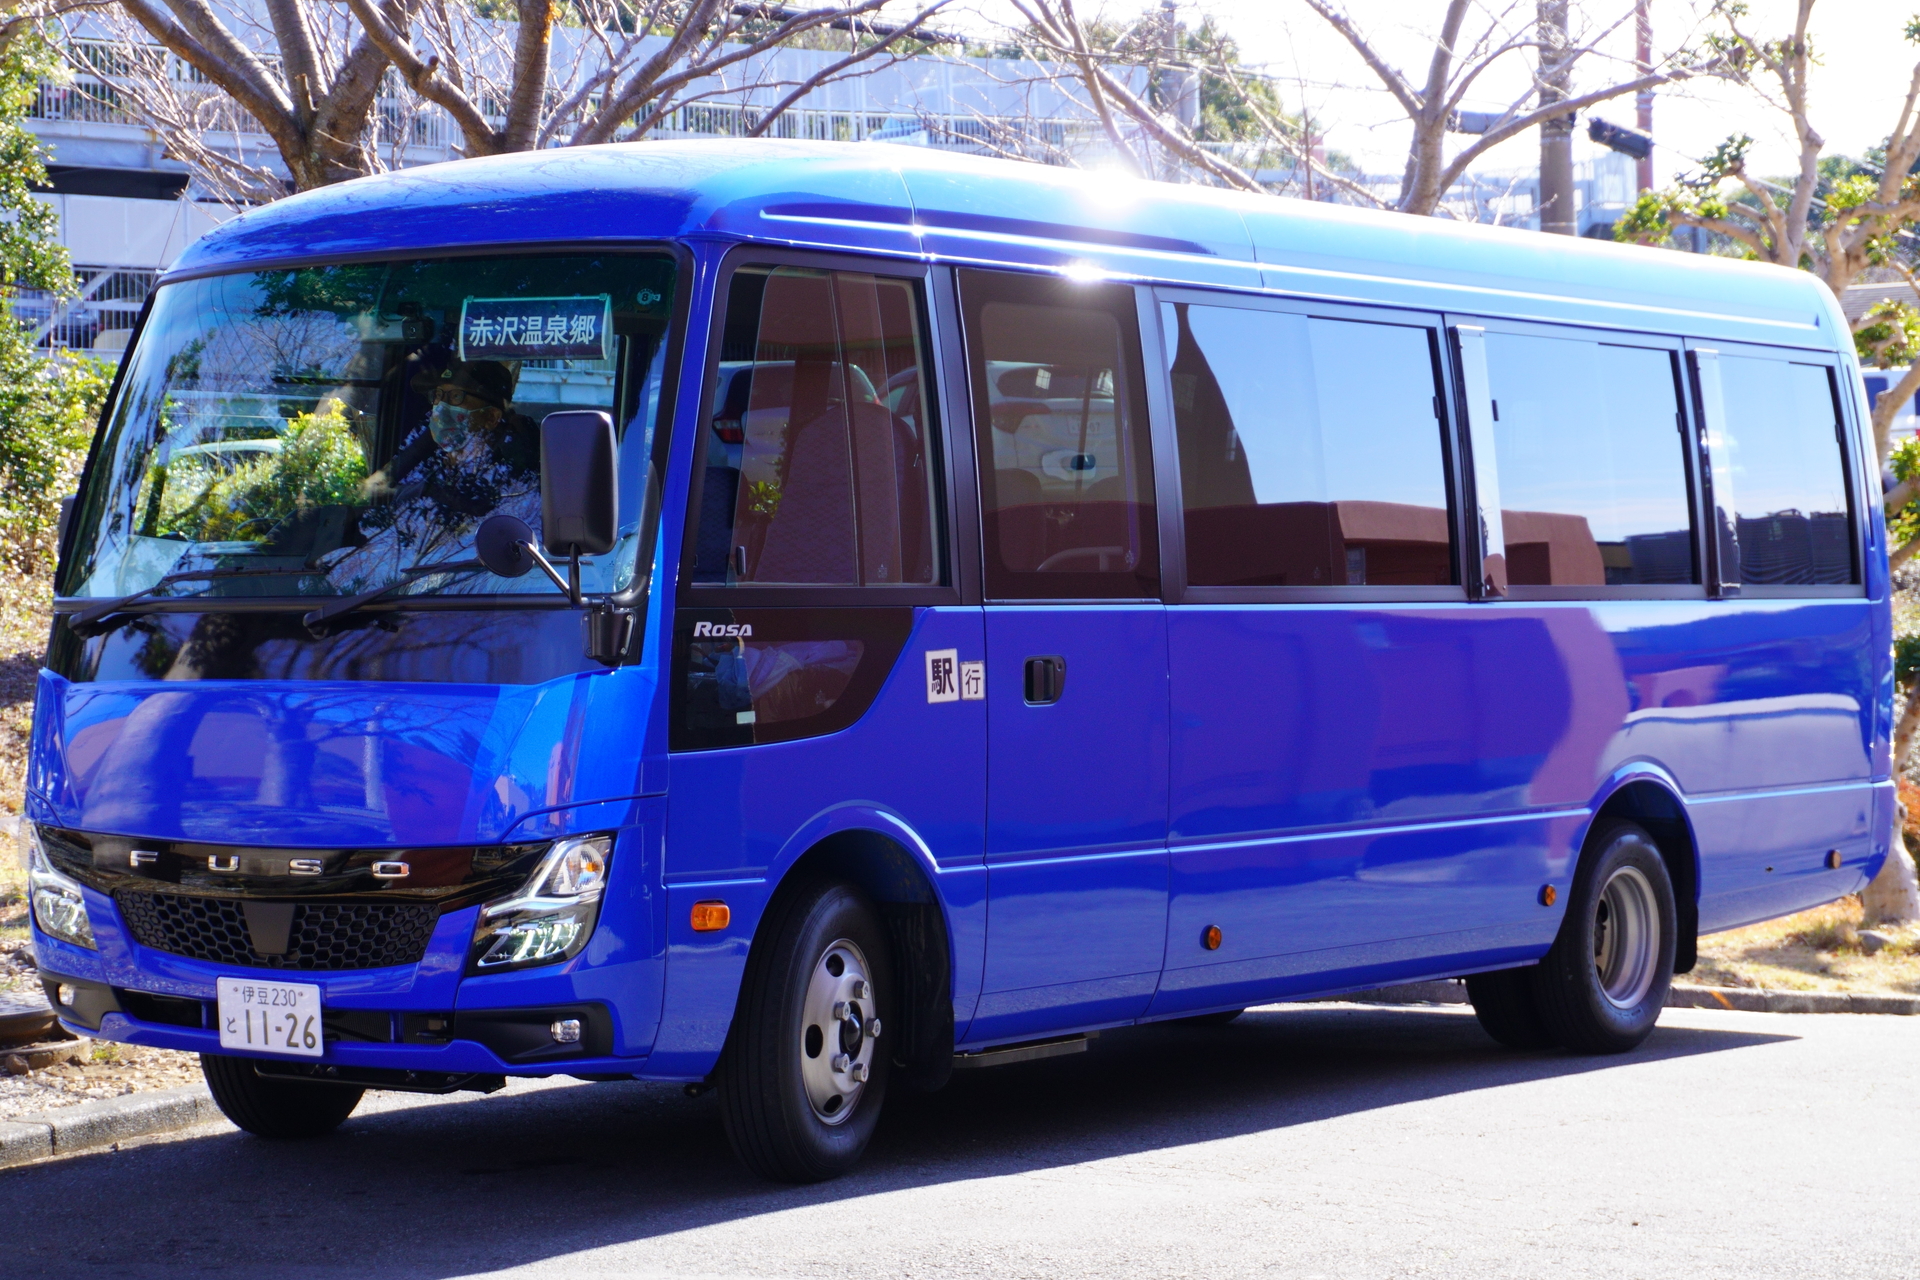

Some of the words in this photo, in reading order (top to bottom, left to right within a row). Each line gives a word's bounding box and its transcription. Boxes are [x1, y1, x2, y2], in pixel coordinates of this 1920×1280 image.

[469, 314, 597, 347] 赤沢温泉郷
[931, 657, 955, 695] 駅
[965, 668, 981, 695] 行
[130, 850, 410, 878] FUSO
[226, 1016, 237, 1034] と
[245, 1009, 316, 1049] 11-26
